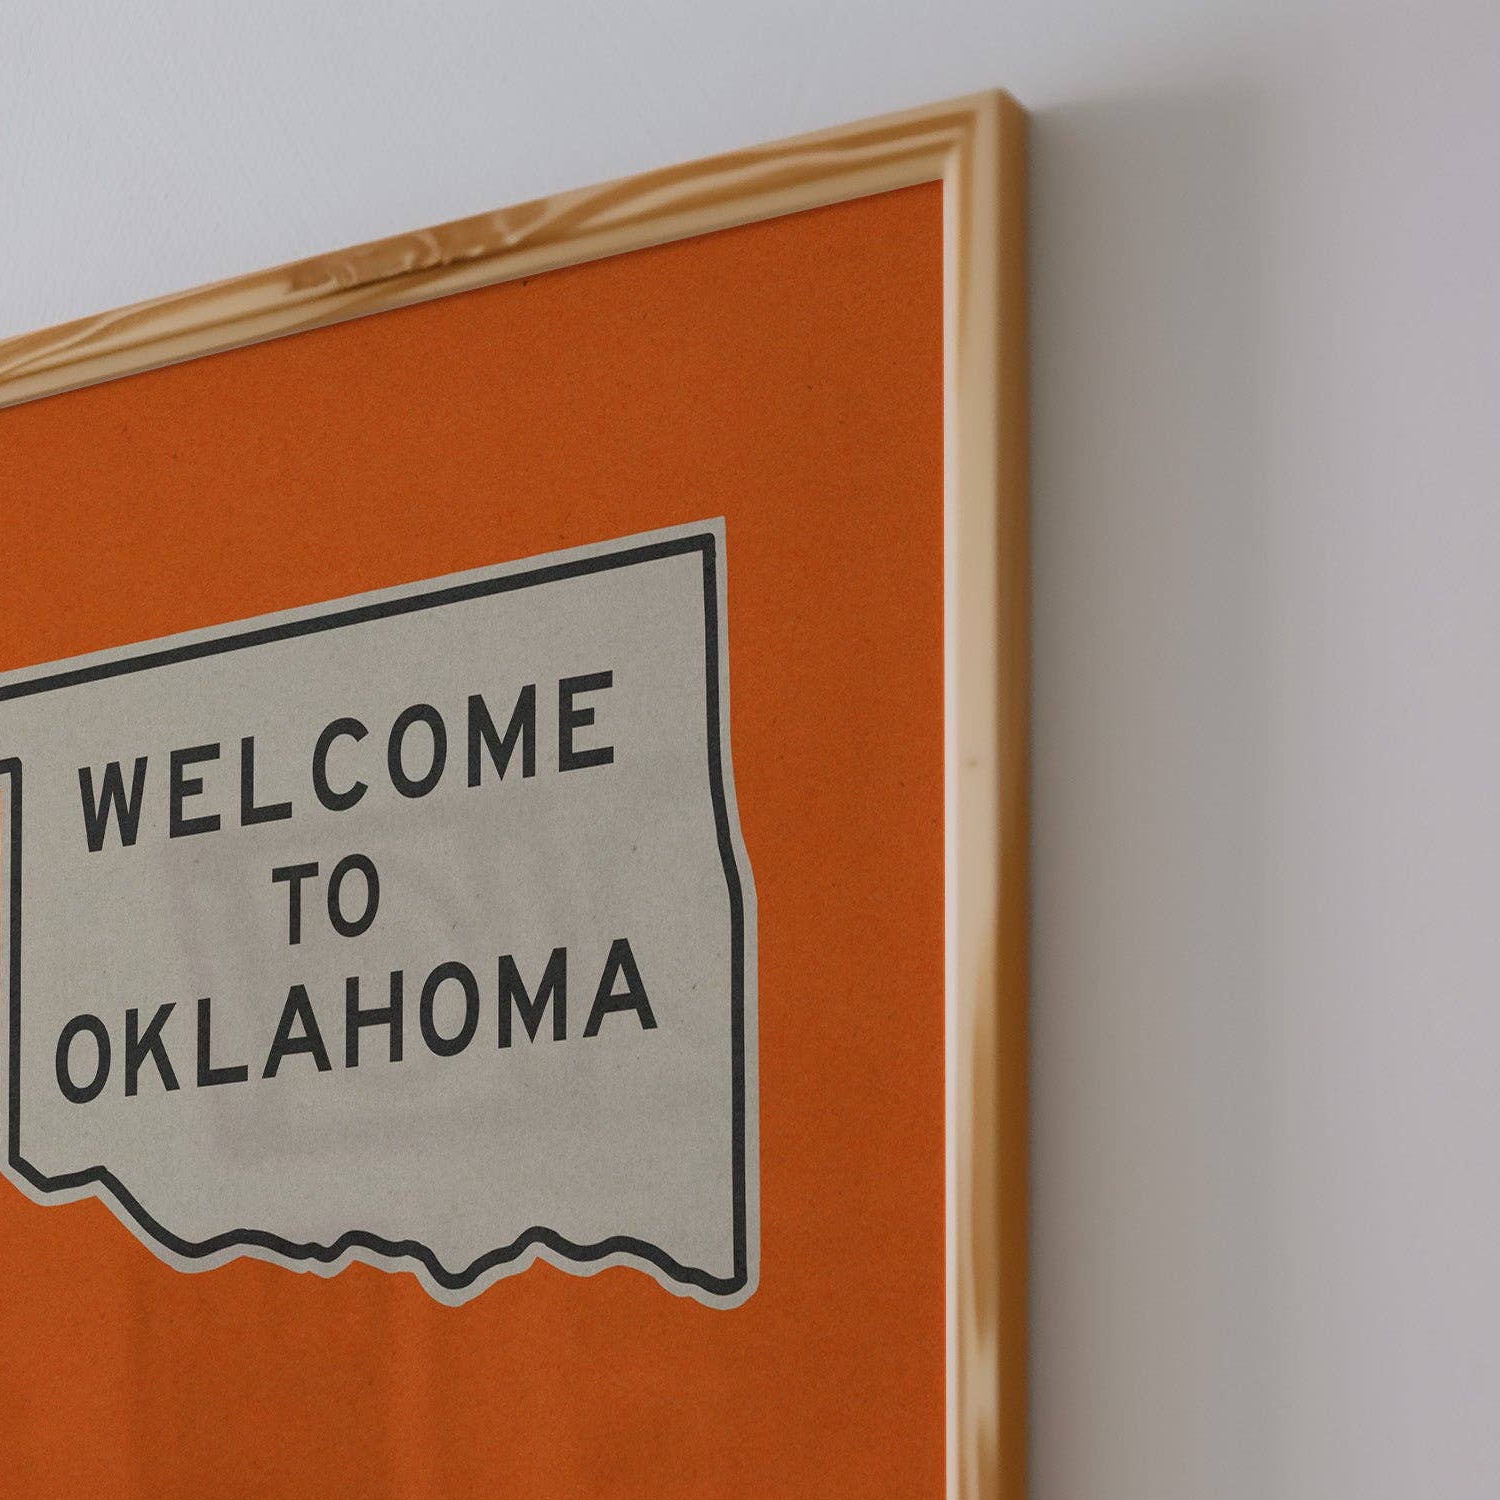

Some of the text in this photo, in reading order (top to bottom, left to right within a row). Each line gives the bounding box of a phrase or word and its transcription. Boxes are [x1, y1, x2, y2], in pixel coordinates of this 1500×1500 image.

[76, 669, 615, 853] WELCOME
[270, 853, 381, 946] TO
[54, 937, 659, 1105] OKLAHOMA
